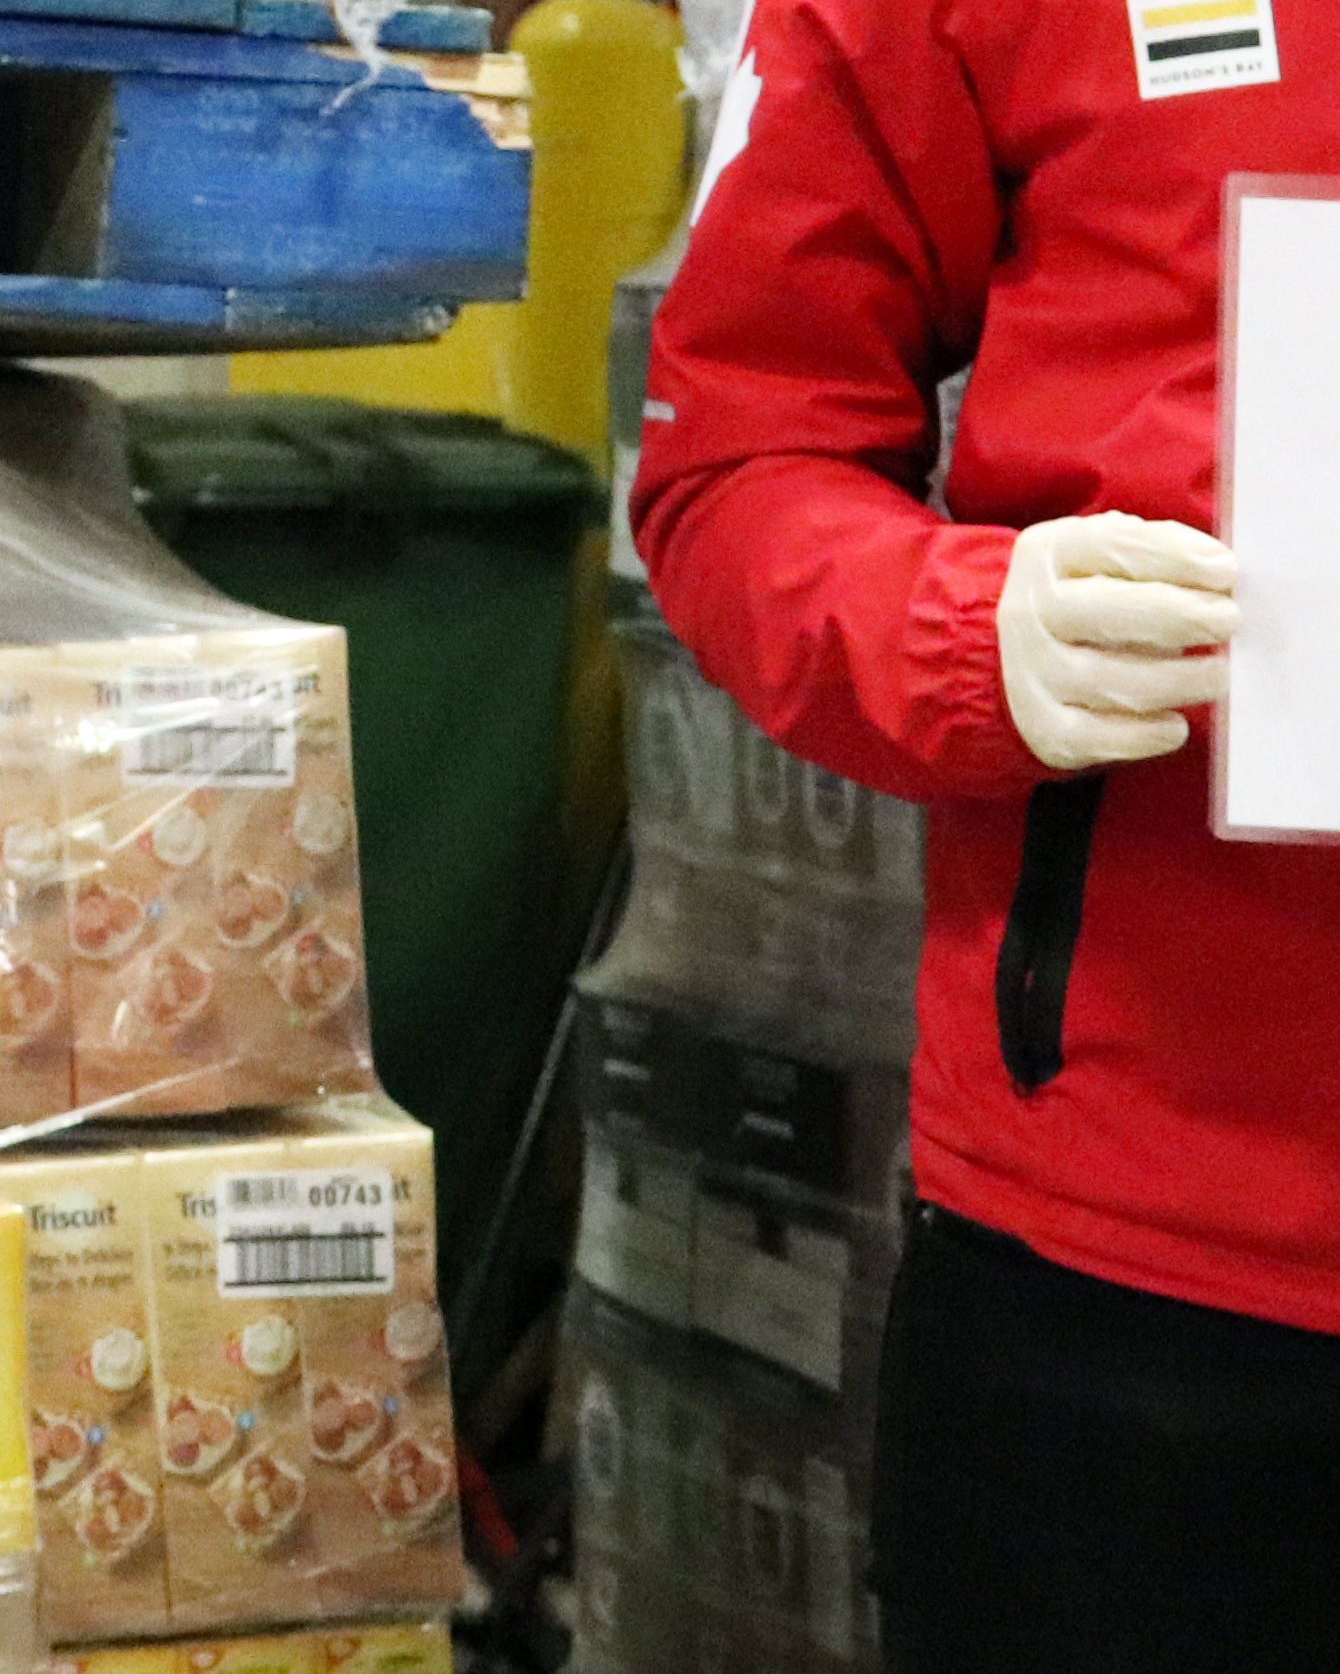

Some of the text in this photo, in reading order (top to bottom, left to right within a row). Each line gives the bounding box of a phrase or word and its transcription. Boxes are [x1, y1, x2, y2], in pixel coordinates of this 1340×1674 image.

[1149, 59, 1265, 86] HUDSON'S BAY
[308, 1183, 384, 1209] 00743
[27, 1202, 118, 1232] Triscuit
